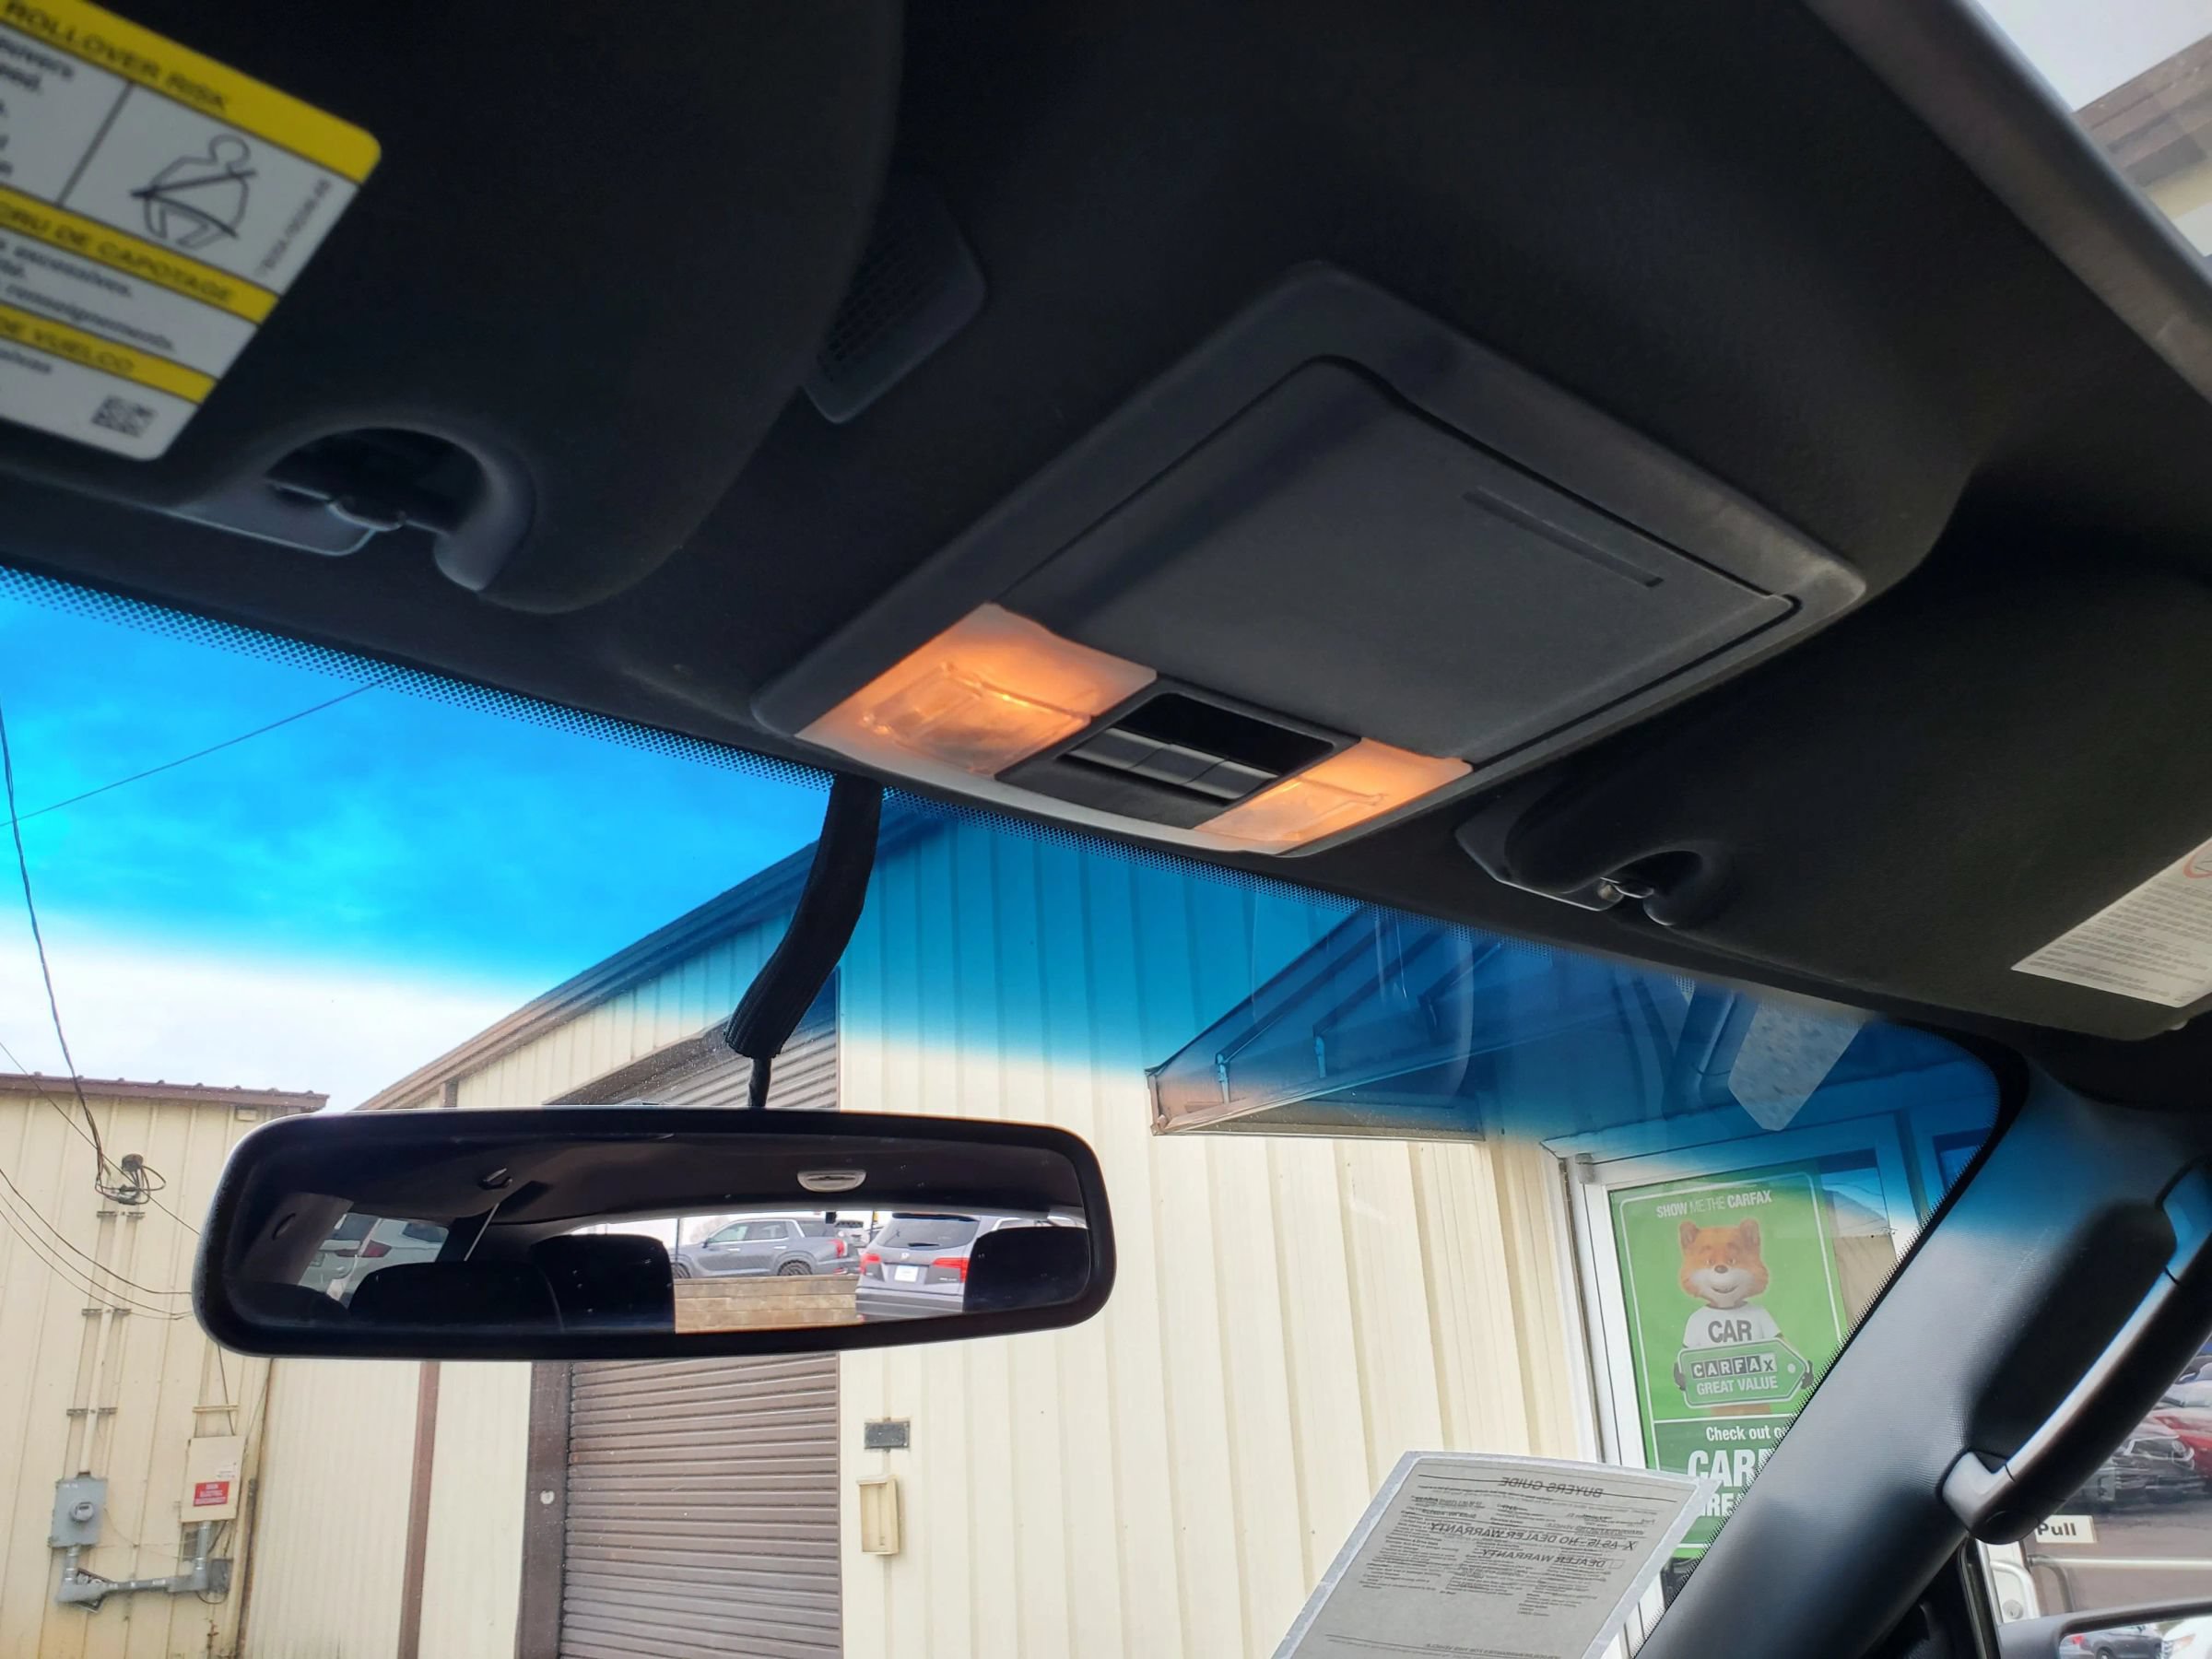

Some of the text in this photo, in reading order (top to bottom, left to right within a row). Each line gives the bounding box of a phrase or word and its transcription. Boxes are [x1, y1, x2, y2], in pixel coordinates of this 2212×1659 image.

[1655, 1202, 1688, 1218] SHOW
[1707, 1196, 1726, 1211] THE
[1727, 1190, 1772, 1209] CARFAX
[1708, 1319, 1752, 1343] CAR
[1692, 1357, 1775, 1378] CARFAX
[1696, 1375, 1779, 1395] GREAT VALUE
[1706, 1426, 1746, 1441] Check
[1748, 1426, 1771, 1440] out
[2037, 1522, 2077, 1536] Pull
